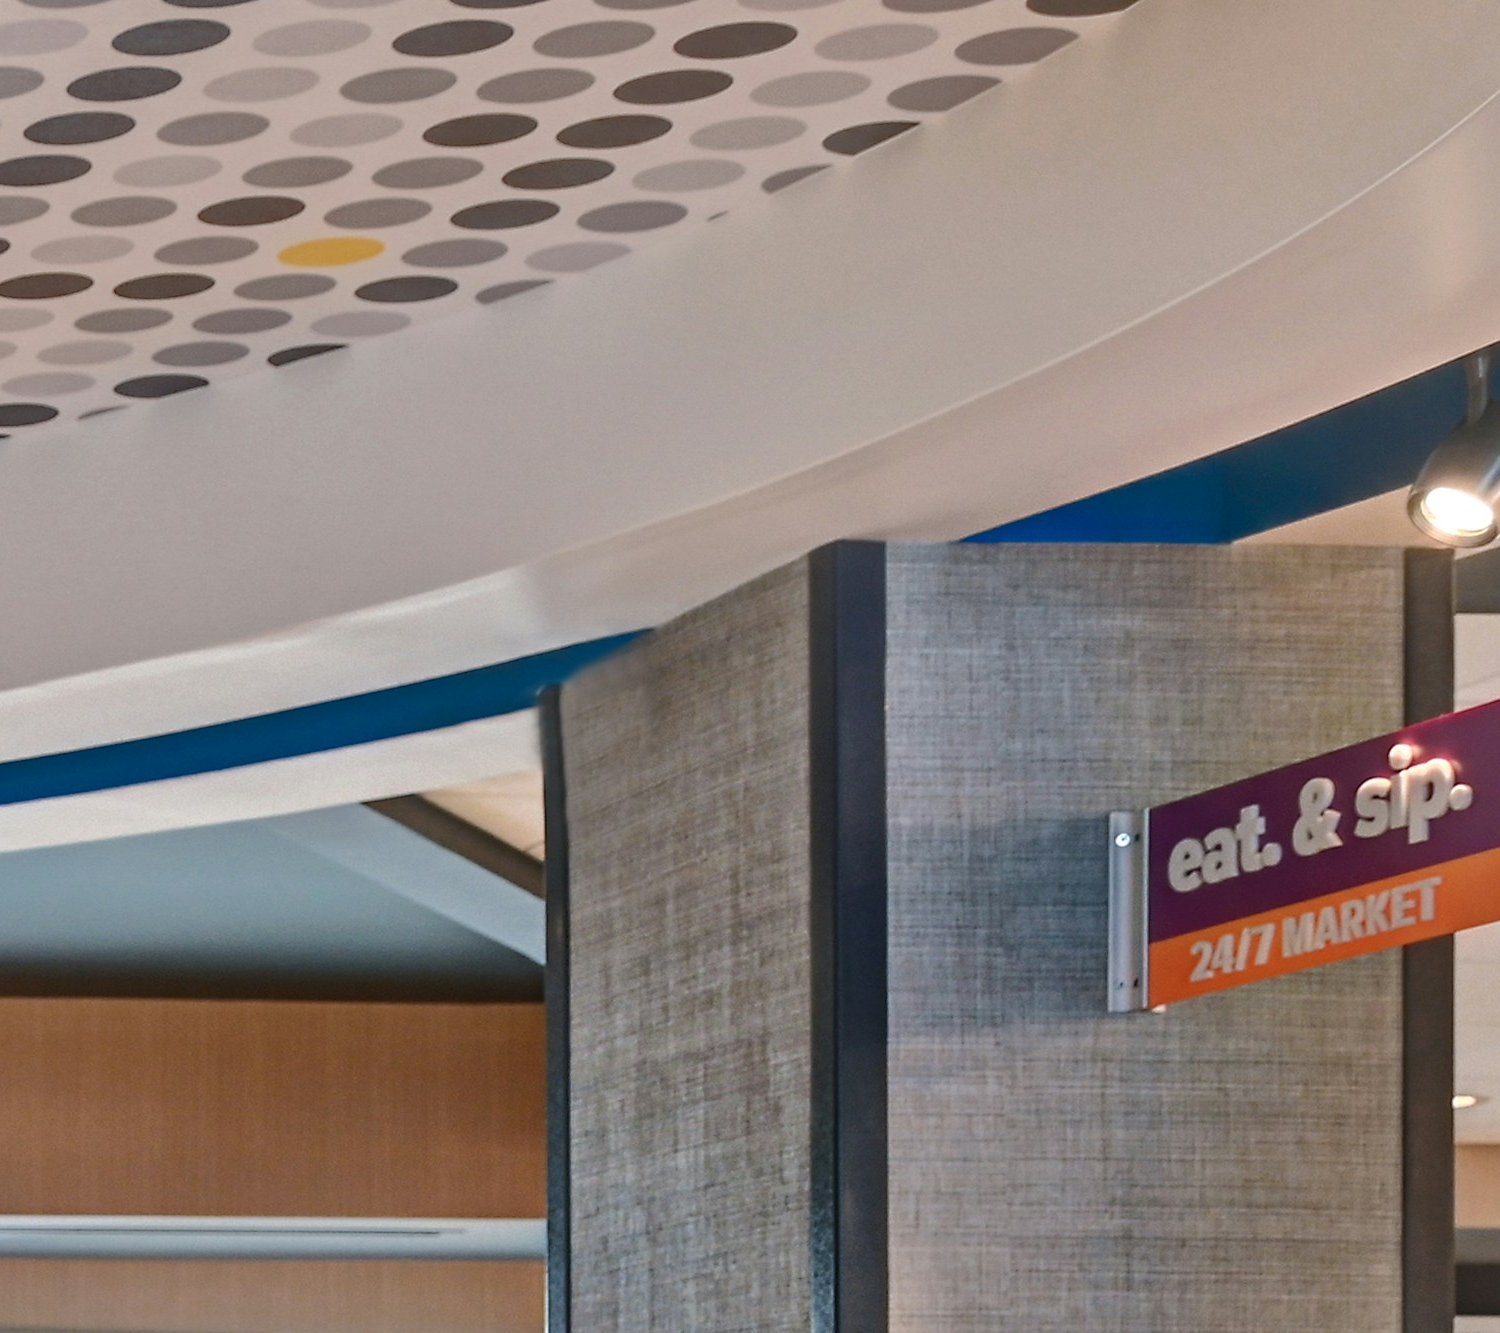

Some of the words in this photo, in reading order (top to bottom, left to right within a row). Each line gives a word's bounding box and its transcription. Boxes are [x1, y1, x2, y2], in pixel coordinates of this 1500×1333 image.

[1168, 803, 1282, 892] eat.
[1292, 777, 1344, 857] &
[1354, 743, 1473, 844] sip.
[1189, 922, 1276, 982] 24/7
[1281, 876, 1442, 958] MARKET
